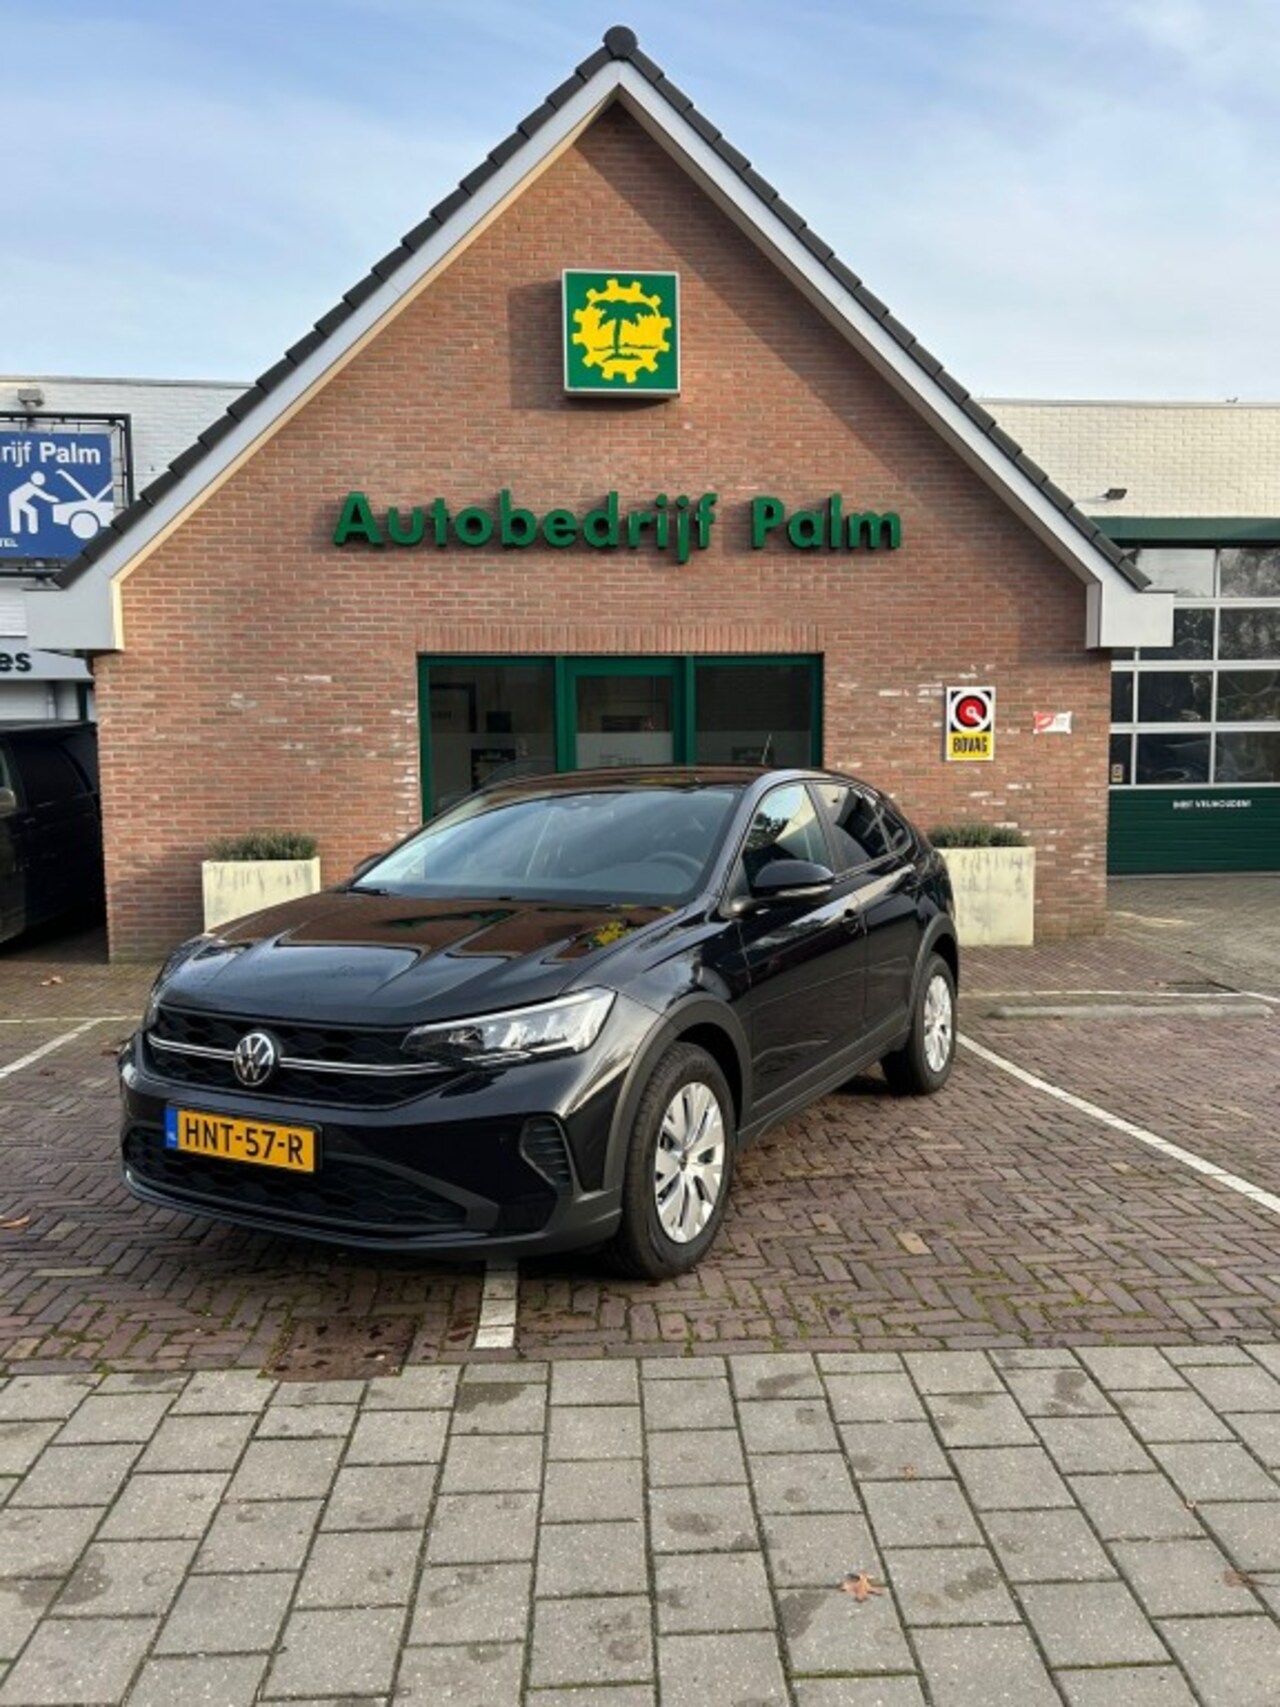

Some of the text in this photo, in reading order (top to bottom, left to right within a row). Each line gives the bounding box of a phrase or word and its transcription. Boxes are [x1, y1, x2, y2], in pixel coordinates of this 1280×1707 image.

[1, 441, 101, 467] rijf Palm
[333, 489, 902, 564] Autobedrijf Palm
[184, 1117, 304, 1165] HNT-57-R
